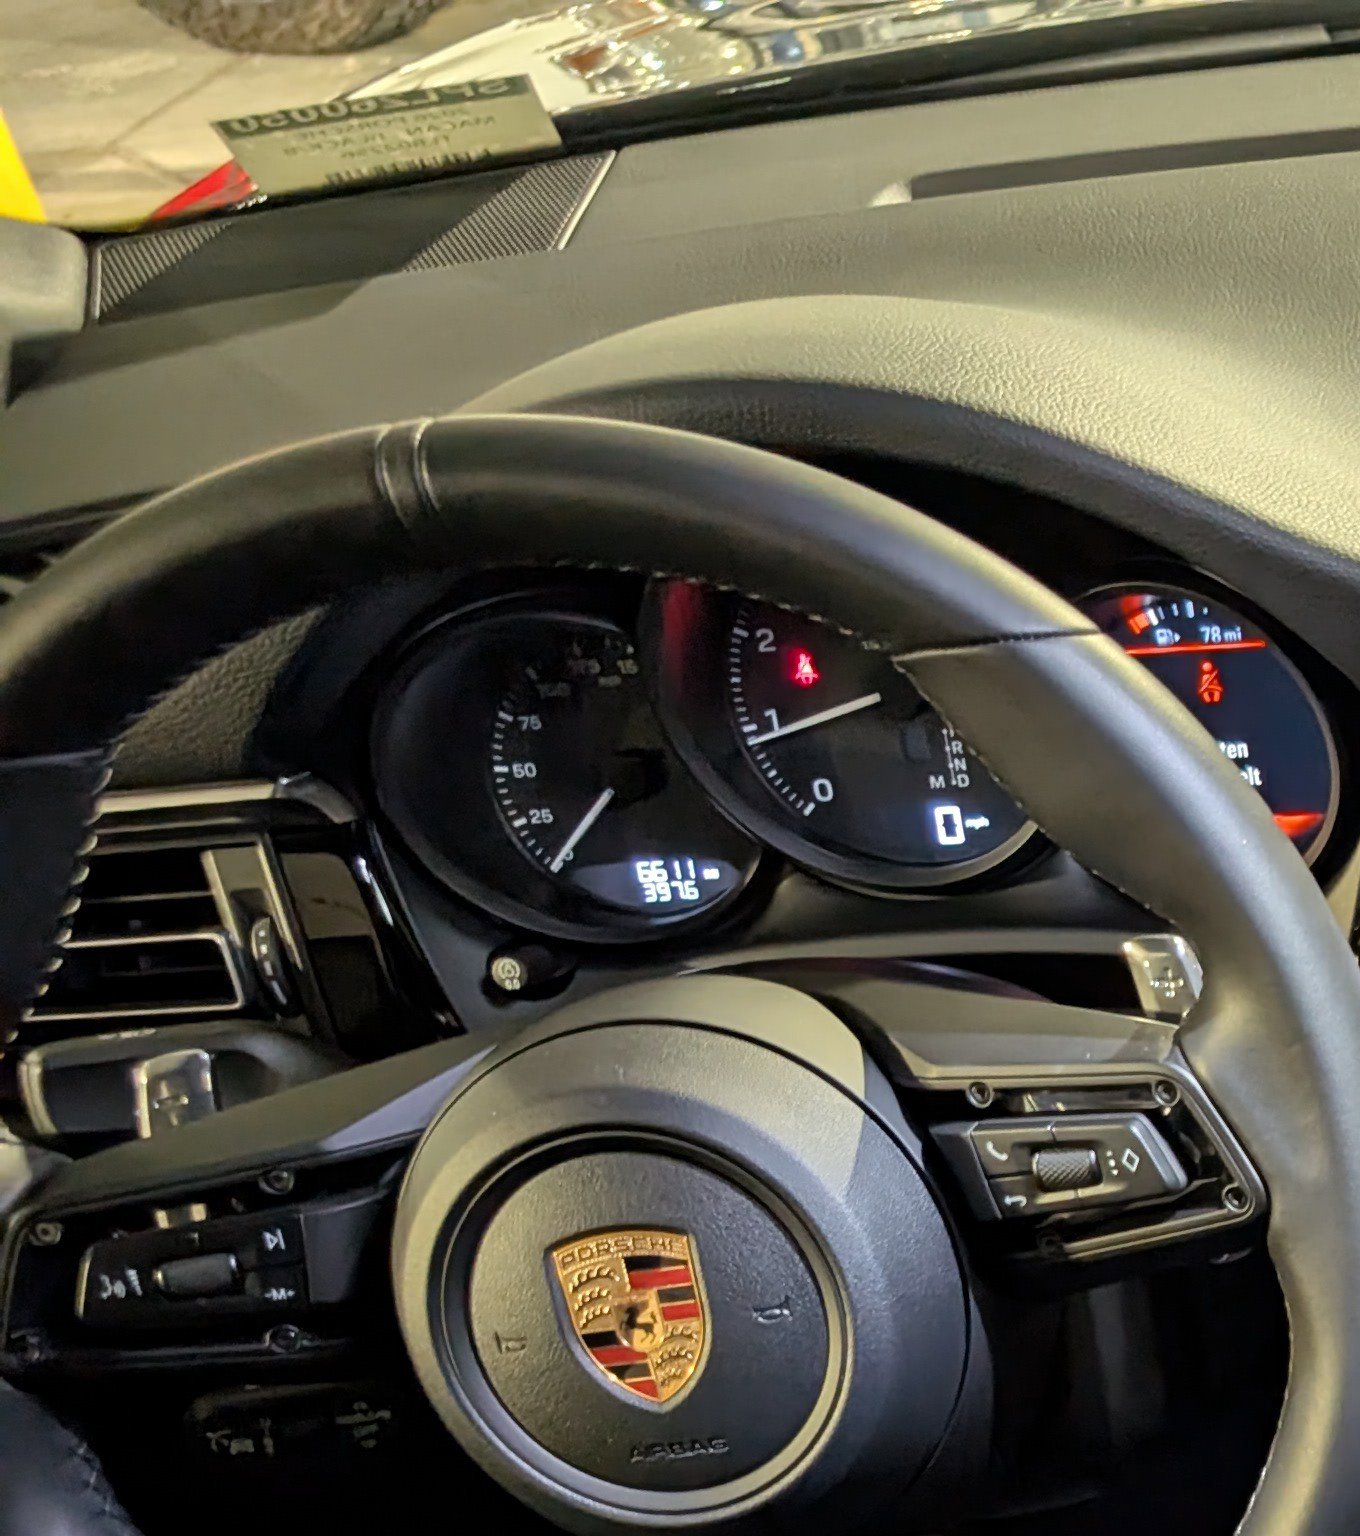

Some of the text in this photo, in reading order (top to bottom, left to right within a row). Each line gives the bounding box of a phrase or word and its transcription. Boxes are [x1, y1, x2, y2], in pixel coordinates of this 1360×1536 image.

[755, 627, 776, 653] 2
[1200, 625, 1242, 643] 78 mi
[517, 715, 542, 732] 75
[764, 708, 780, 731] 1
[951, 741, 964, 755] R
[512, 762, 537, 779] 50
[953, 757, 967, 771] N
[928, 775, 946, 789] M
[957, 773, 970, 788] D
[812, 778, 834, 803] 0
[529, 808, 554, 825] 25
[933, 805, 966, 846] 0
[636, 859, 696, 883] 6611
[561, 1235, 687, 1270] PORSCHE
